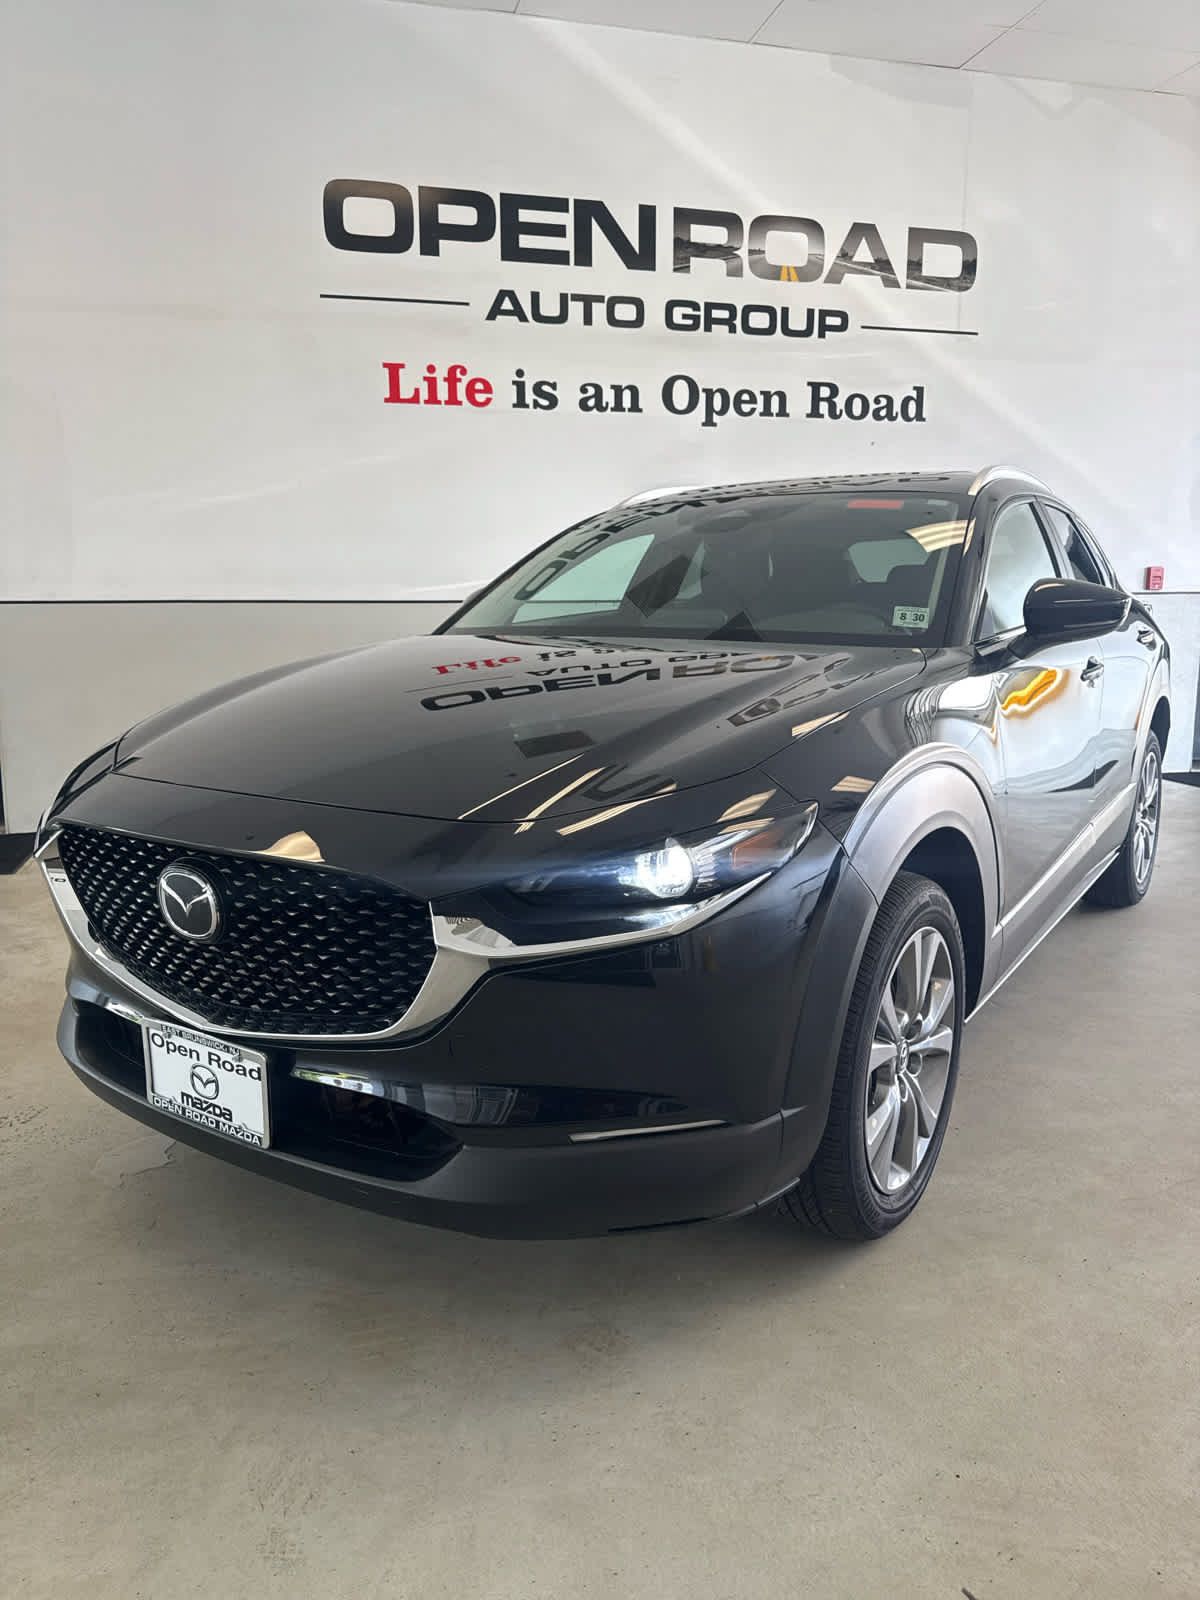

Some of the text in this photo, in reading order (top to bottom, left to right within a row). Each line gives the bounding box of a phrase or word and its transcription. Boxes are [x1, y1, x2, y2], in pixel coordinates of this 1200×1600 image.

[323, 179, 978, 293] OPEN ROAD
[485, 289, 849, 339] AUTO GROUP
[382, 362, 926, 427] Life is an Open Road
[912, 613, 925, 622] 30
[151, 1033, 261, 1081] Open Road
[154, 1096, 261, 1145] OPEN ROAD MAZDA
[181, 1092, 233, 1122] mazda
